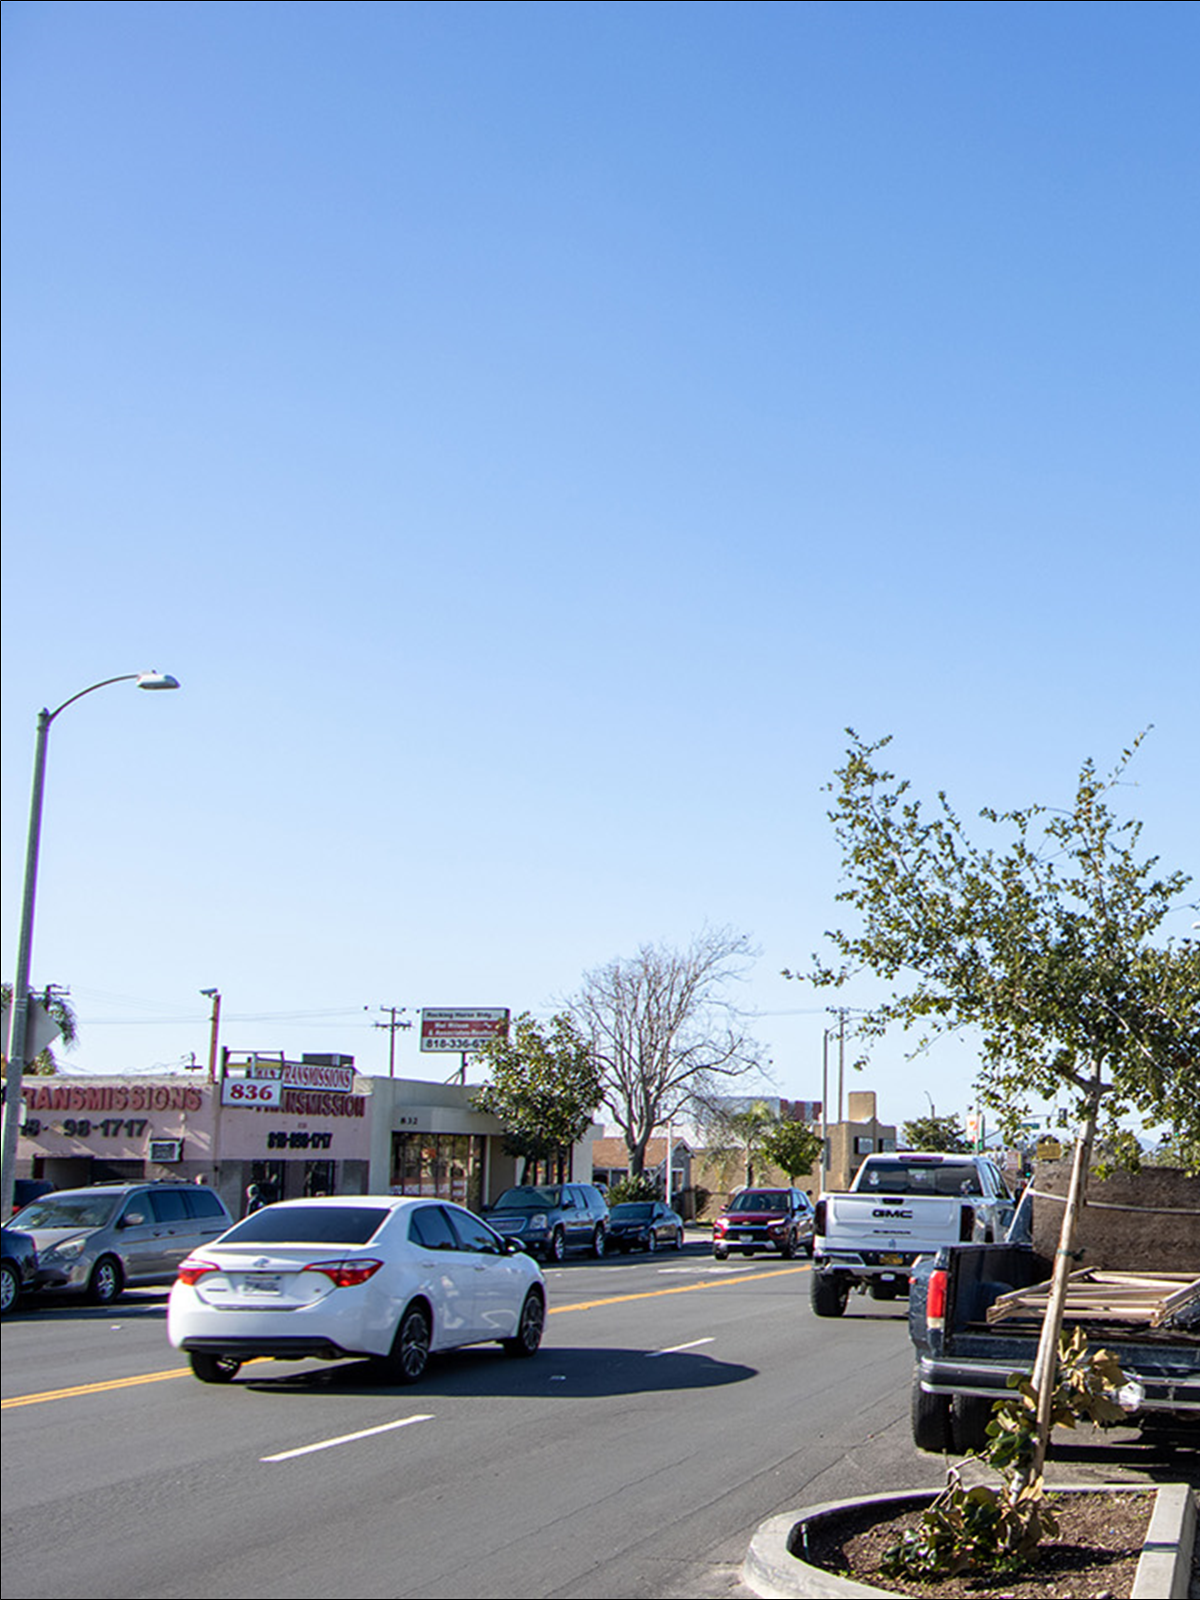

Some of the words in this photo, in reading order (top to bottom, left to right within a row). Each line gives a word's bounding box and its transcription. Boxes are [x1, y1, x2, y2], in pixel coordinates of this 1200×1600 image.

[283, 1065, 351, 1088] RANSMISSIONS
[21, 1085, 202, 1111] RANSMISSIONS
[230, 1084, 273, 1101] 836
[872, 1209, 913, 1219] GMC
